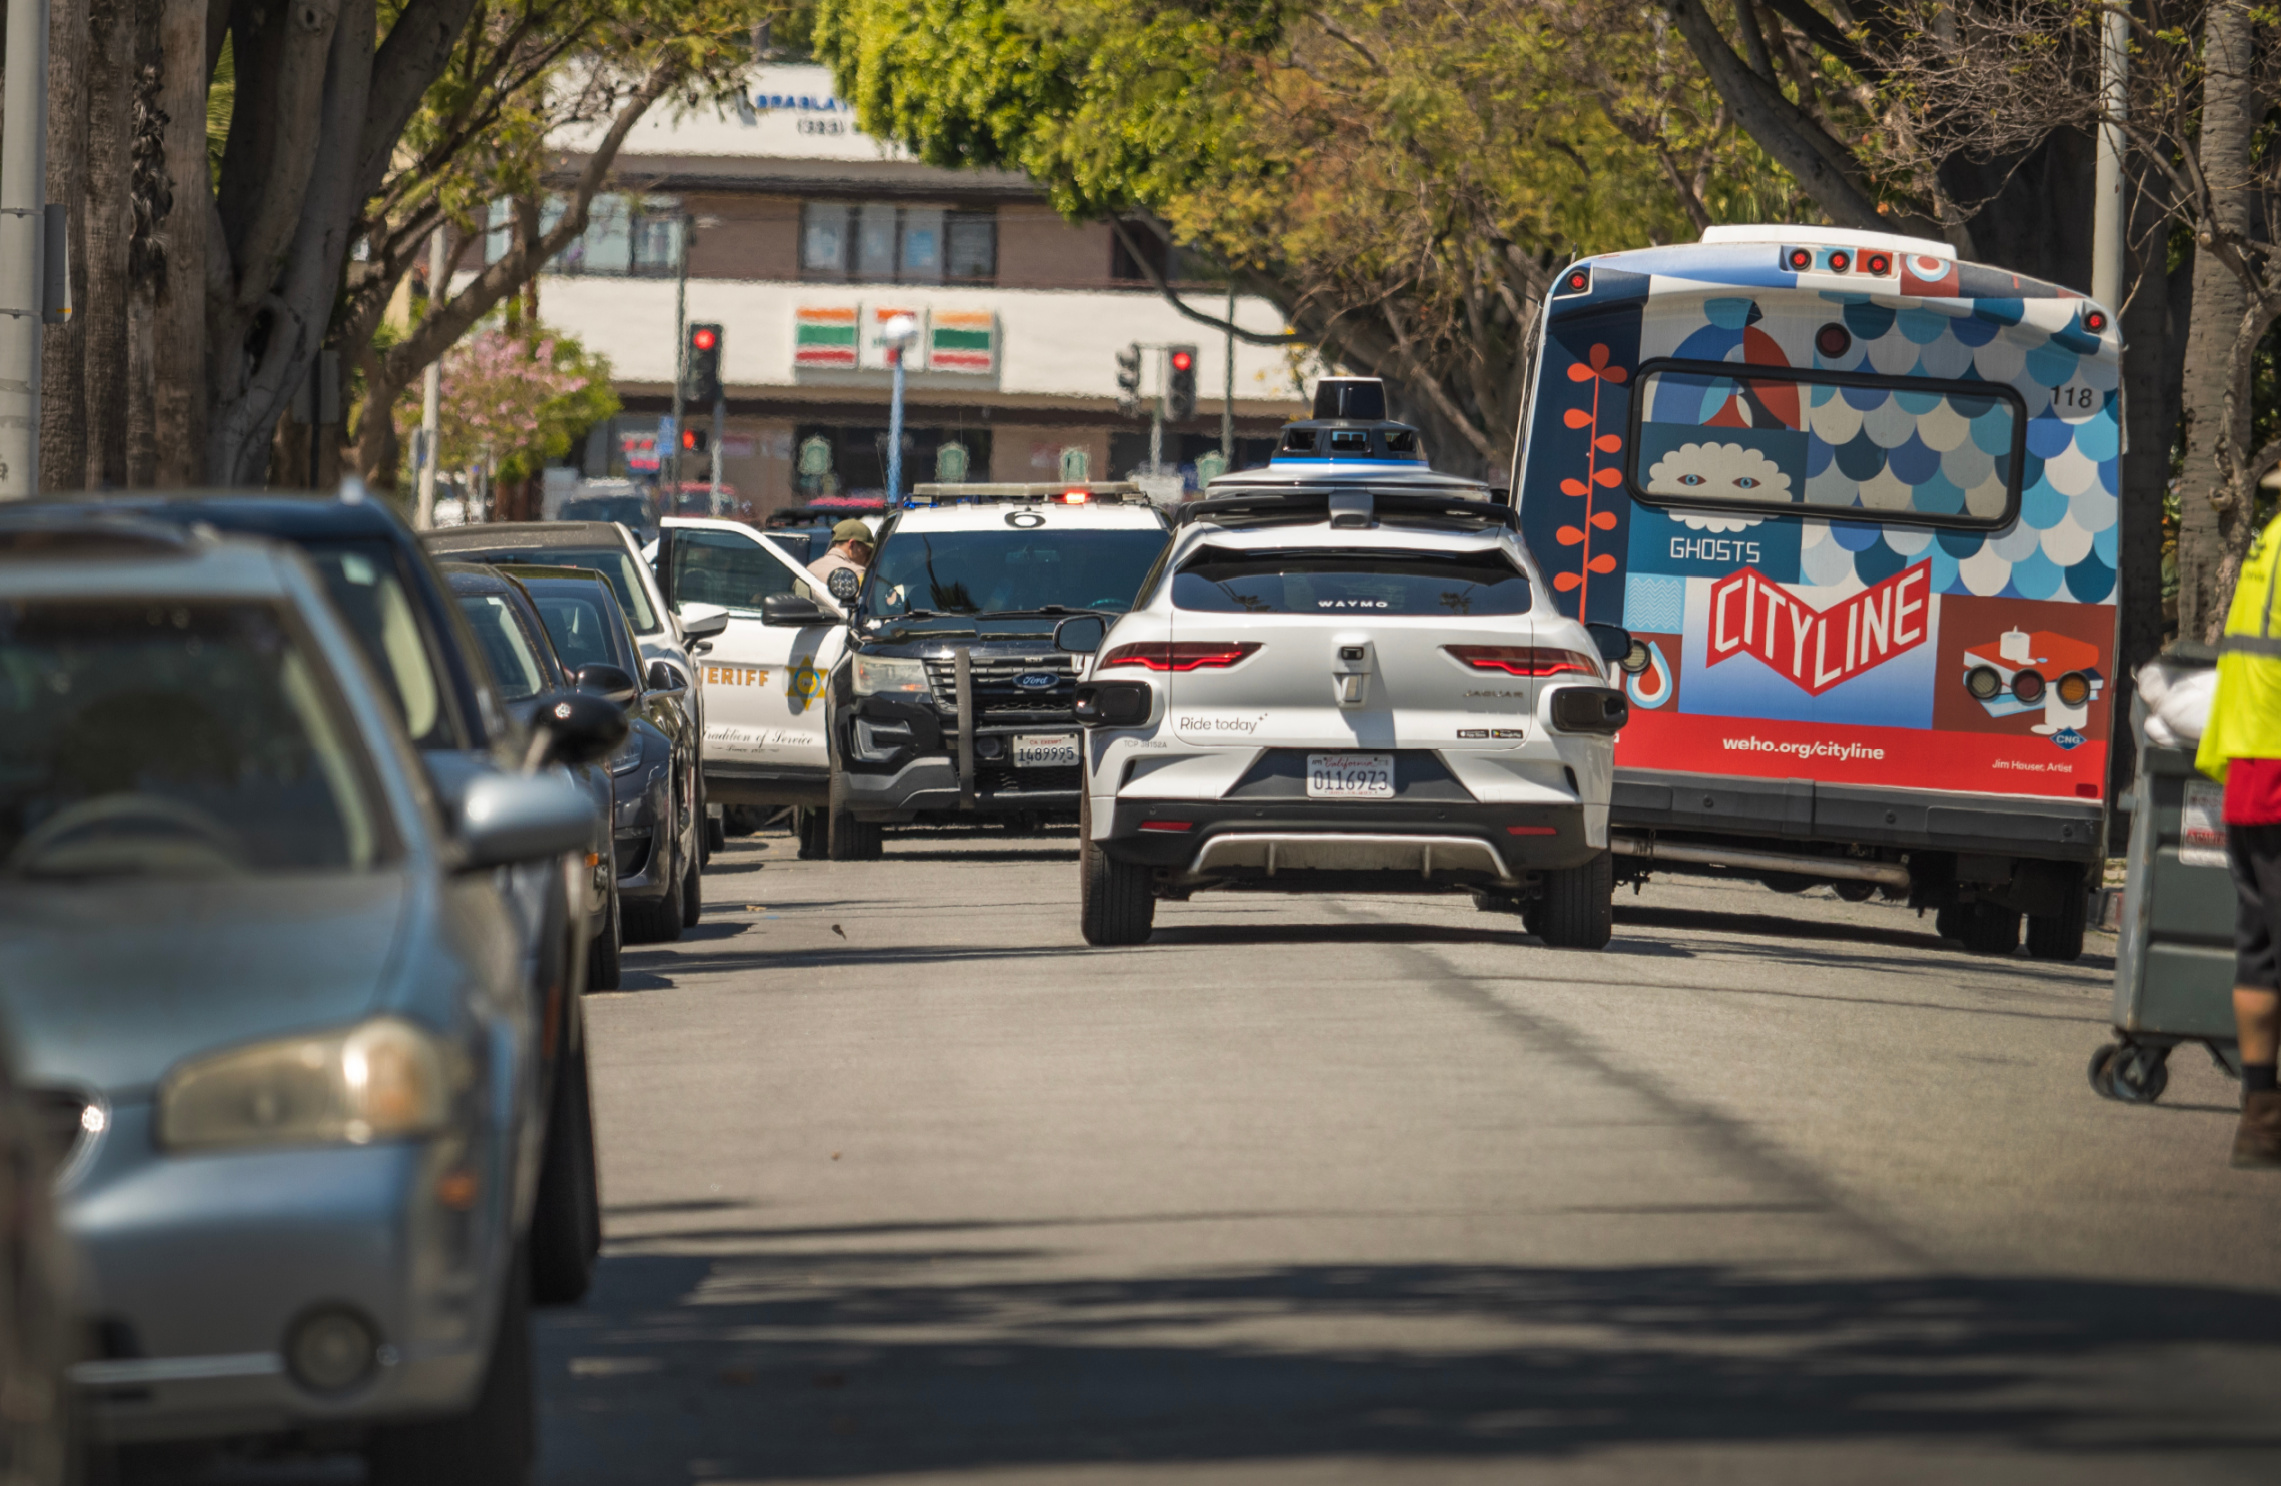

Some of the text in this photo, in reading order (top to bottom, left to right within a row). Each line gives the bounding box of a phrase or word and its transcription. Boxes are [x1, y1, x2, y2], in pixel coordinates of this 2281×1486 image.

[2050, 385, 2092, 409] 118
[1004, 510, 1047, 529] 6
[1670, 537, 1760, 563] GHOSTS
[1318, 600, 1388, 608] WAYMO
[1714, 567, 1924, 689] CITYLINE
[1022, 676, 1048, 685] Ford
[1463, 689, 1524, 698] JAGUAR
[1180, 716, 1258, 735] Ride today
[755, 729, 770, 749] of
[771, 730, 813, 745] Service
[1124, 740, 1139, 748] TCP
[2056, 734, 2081, 744] CNG
[1018, 747, 1075, 762] 1489995
[1723, 735, 1885, 761] weho.org/cityline
[1325, 756, 1377, 770] California
[1992, 758, 2009, 769] Jim
[2047, 762, 2073, 773] Artist
[1313, 770, 1388, 791] 01169Z3
